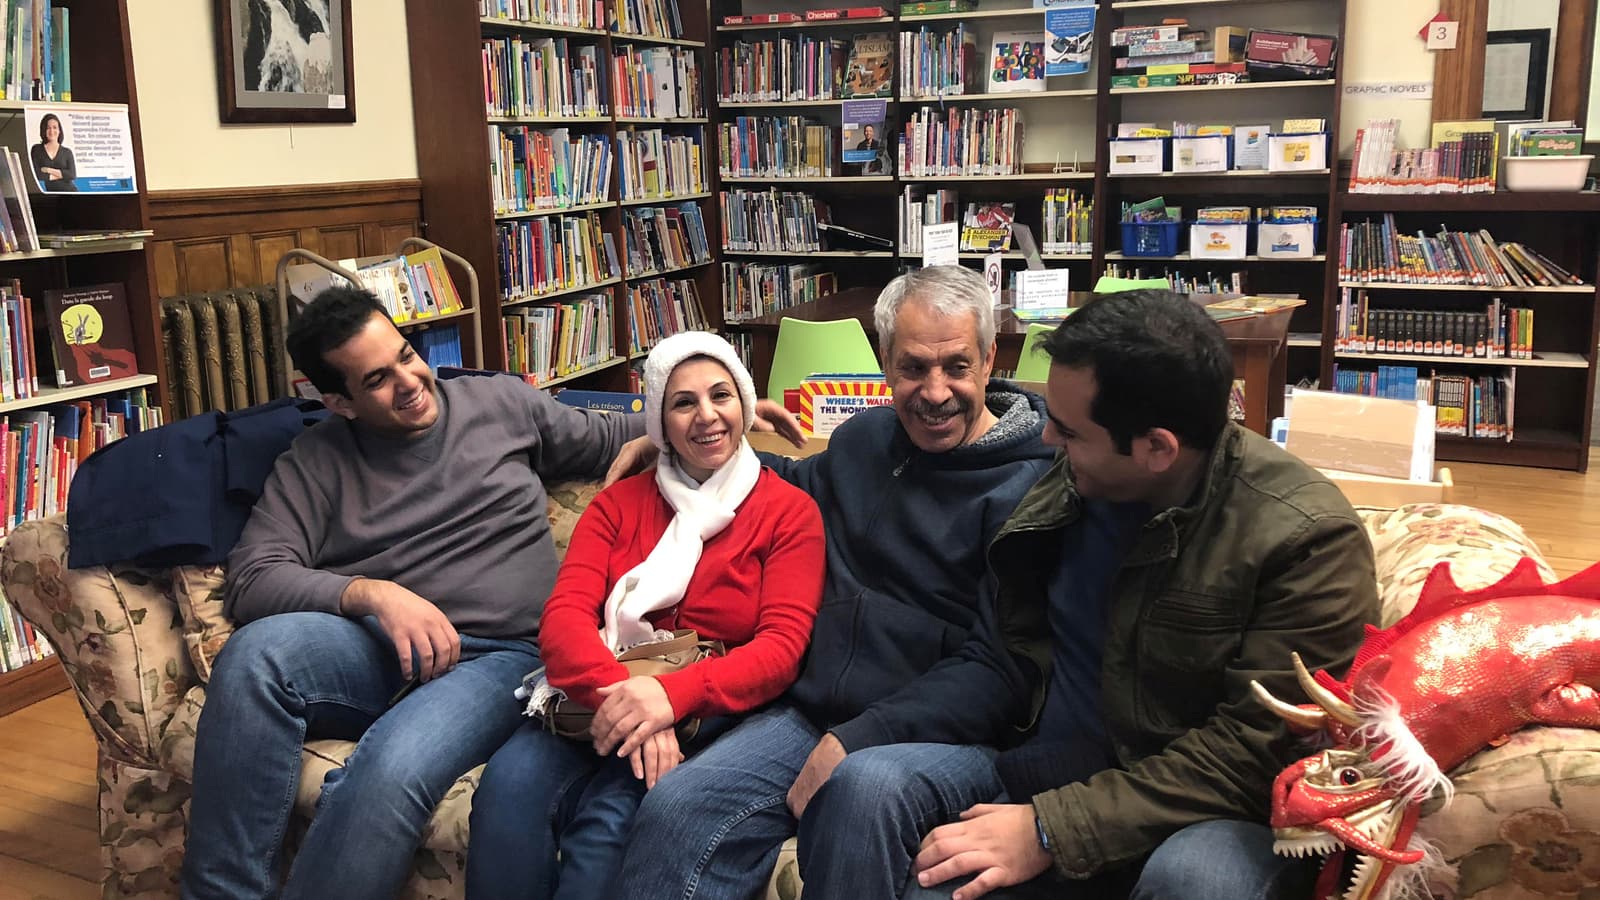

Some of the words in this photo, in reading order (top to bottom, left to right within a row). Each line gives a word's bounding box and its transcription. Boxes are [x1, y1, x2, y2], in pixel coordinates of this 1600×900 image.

[807, 11, 838, 20] Checkers
[1436, 26, 1447, 40] 3
[1344, 85, 1387, 94] GRAPHIC
[1389, 84, 1427, 93] NOVELS
[587, 399, 600, 409] Les
[601, 401, 625, 410] trésors
[825, 397, 864, 406] WHERE'S
[865, 397, 893, 406] WALD
[820, 405, 837, 414] THE
